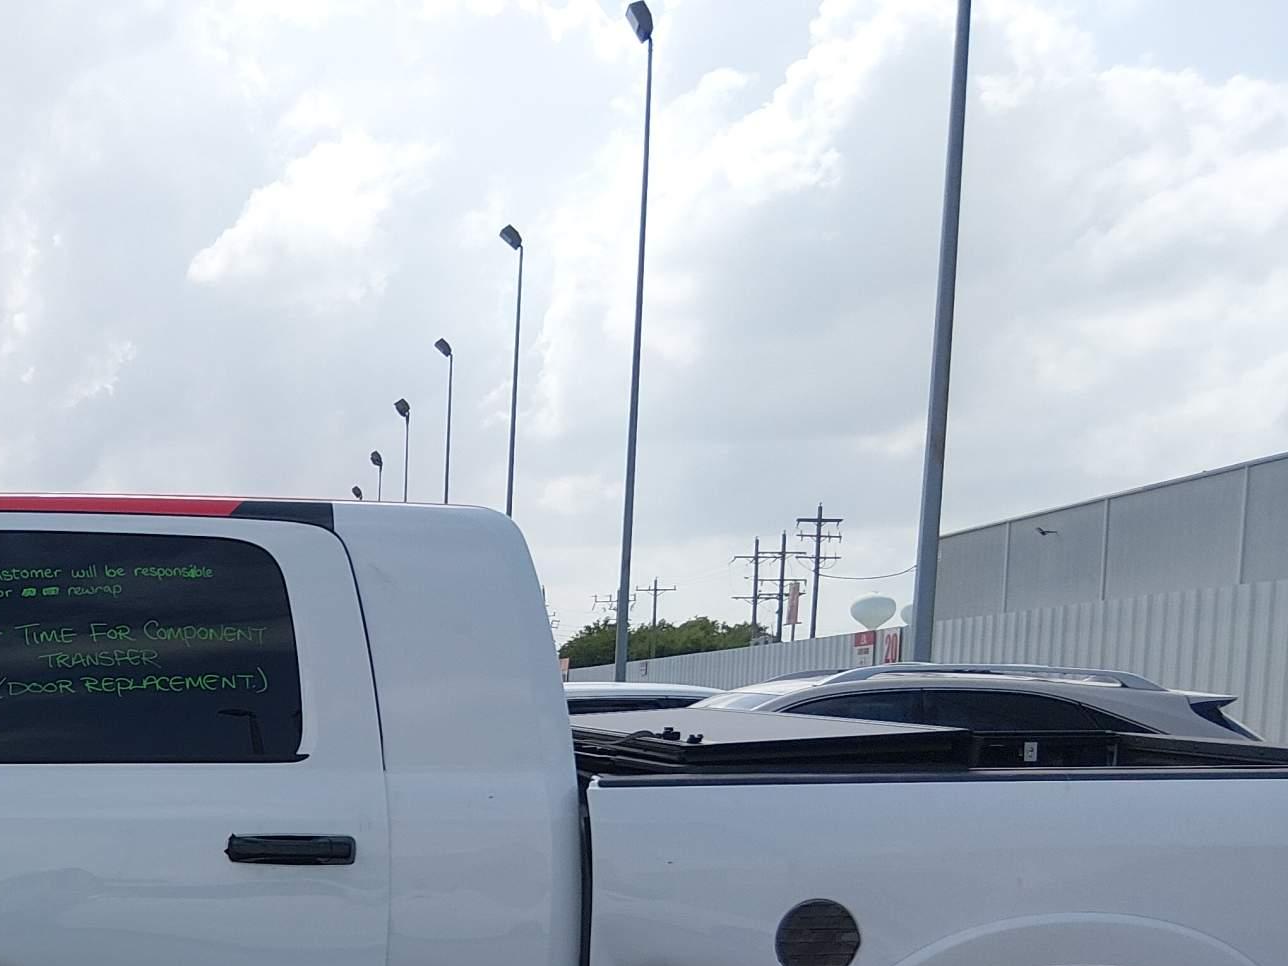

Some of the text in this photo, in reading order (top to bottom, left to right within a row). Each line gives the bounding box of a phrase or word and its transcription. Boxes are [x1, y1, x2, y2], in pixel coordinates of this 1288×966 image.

[71, 564, 97, 578] will
[105, 564, 126, 577] be
[134, 564, 214, 580] responsible
[68, 584, 122, 598] rewrap
[39, 649, 162, 669] TRANSFER
